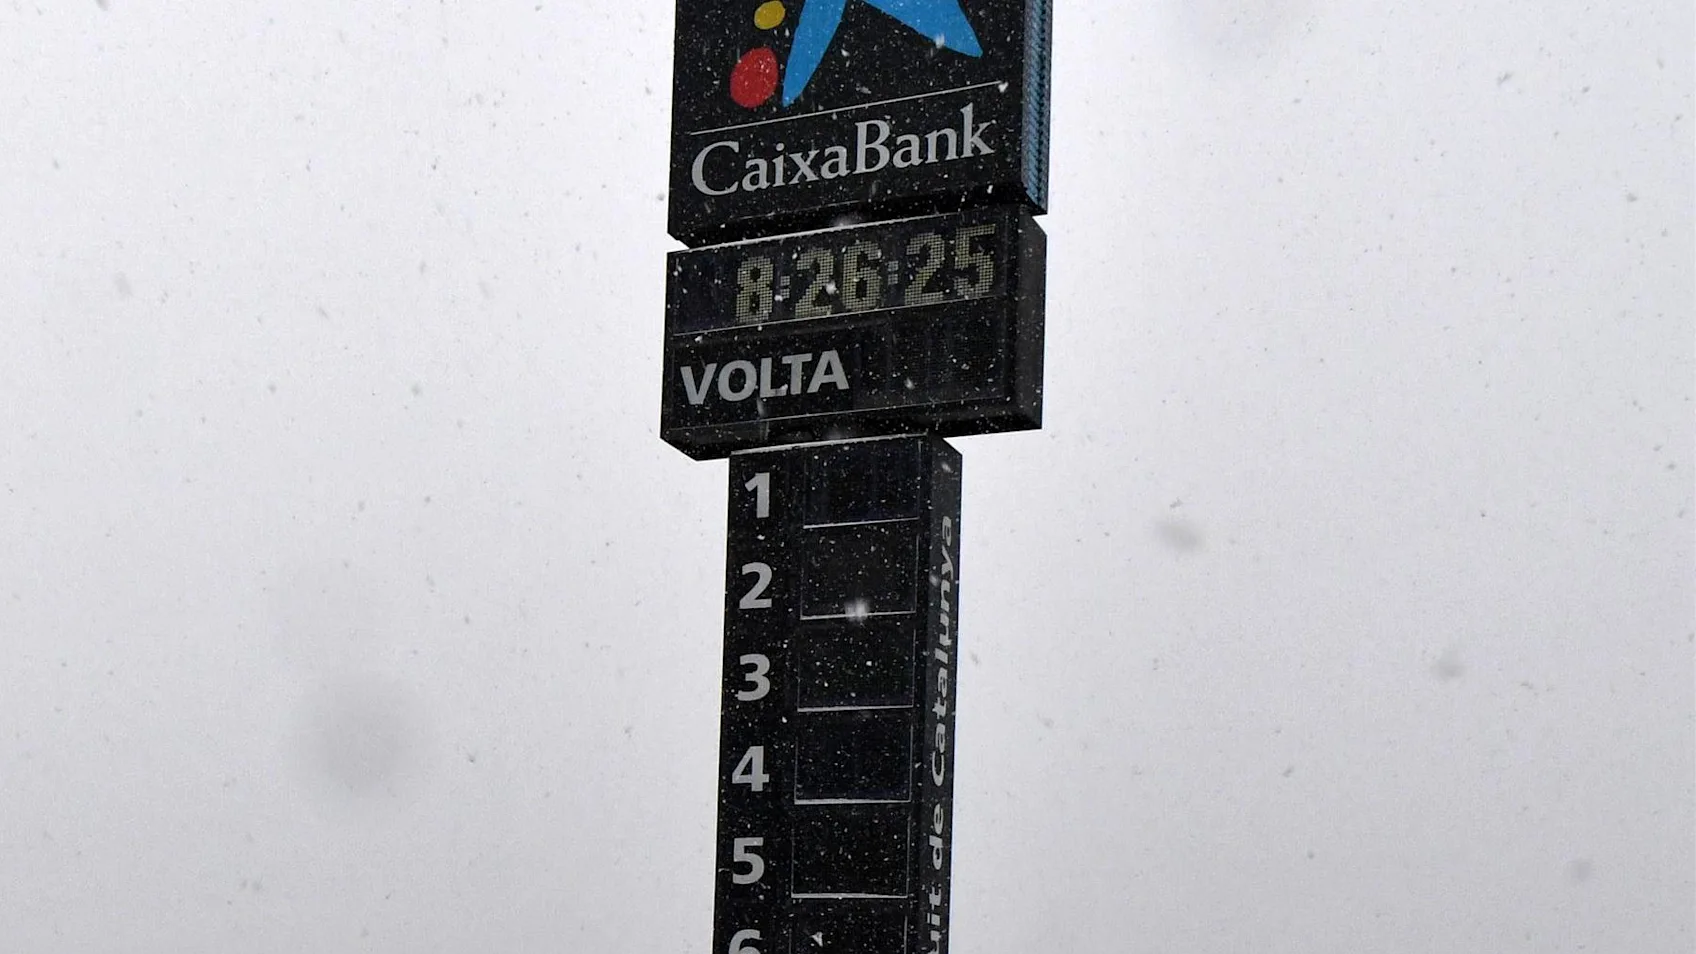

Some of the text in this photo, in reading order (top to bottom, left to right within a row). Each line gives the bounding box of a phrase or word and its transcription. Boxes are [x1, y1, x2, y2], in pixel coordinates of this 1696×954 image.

[691, 103, 996, 197] CaixaBank
[735, 223, 996, 324] 8:26:25
[680, 350, 850, 405] VOLTA
[744, 472, 771, 519] 1
[738, 561, 773, 610] 2
[931, 515, 955, 787] Catalunya
[736, 653, 771, 702] 3
[731, 745, 770, 793] 4
[731, 836, 765, 886] 5
[927, 803, 945, 872] de
